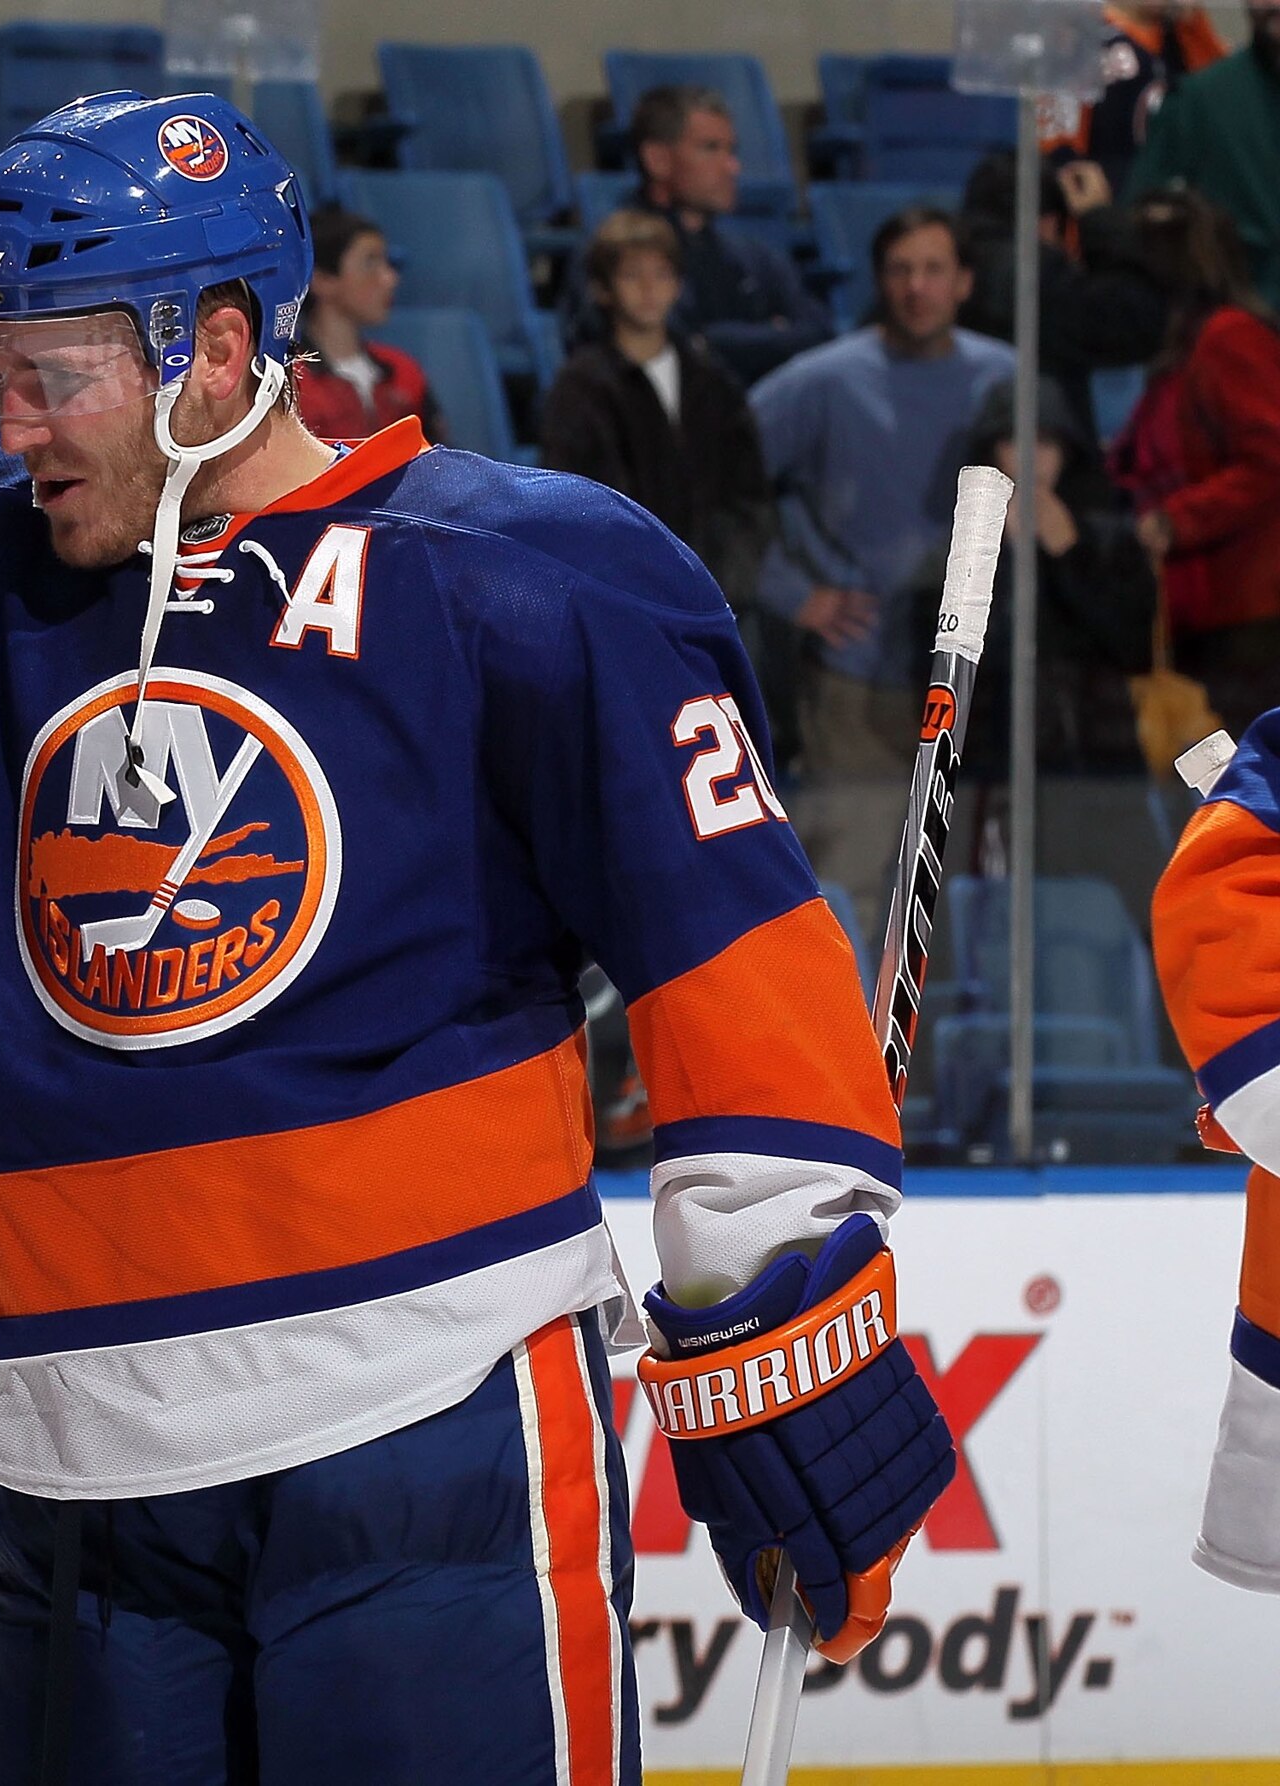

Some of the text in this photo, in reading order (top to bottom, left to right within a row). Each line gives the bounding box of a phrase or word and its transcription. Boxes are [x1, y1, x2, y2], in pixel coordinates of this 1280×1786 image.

[269, 523, 371, 660] A
[939, 613, 959, 632] 20
[67, 700, 265, 850] NY
[38, 892, 281, 1010] ISLANDERS
[678, 1317, 760, 1348] WISNIEWSKI
[803, 1585, 1114, 1721] ody.
